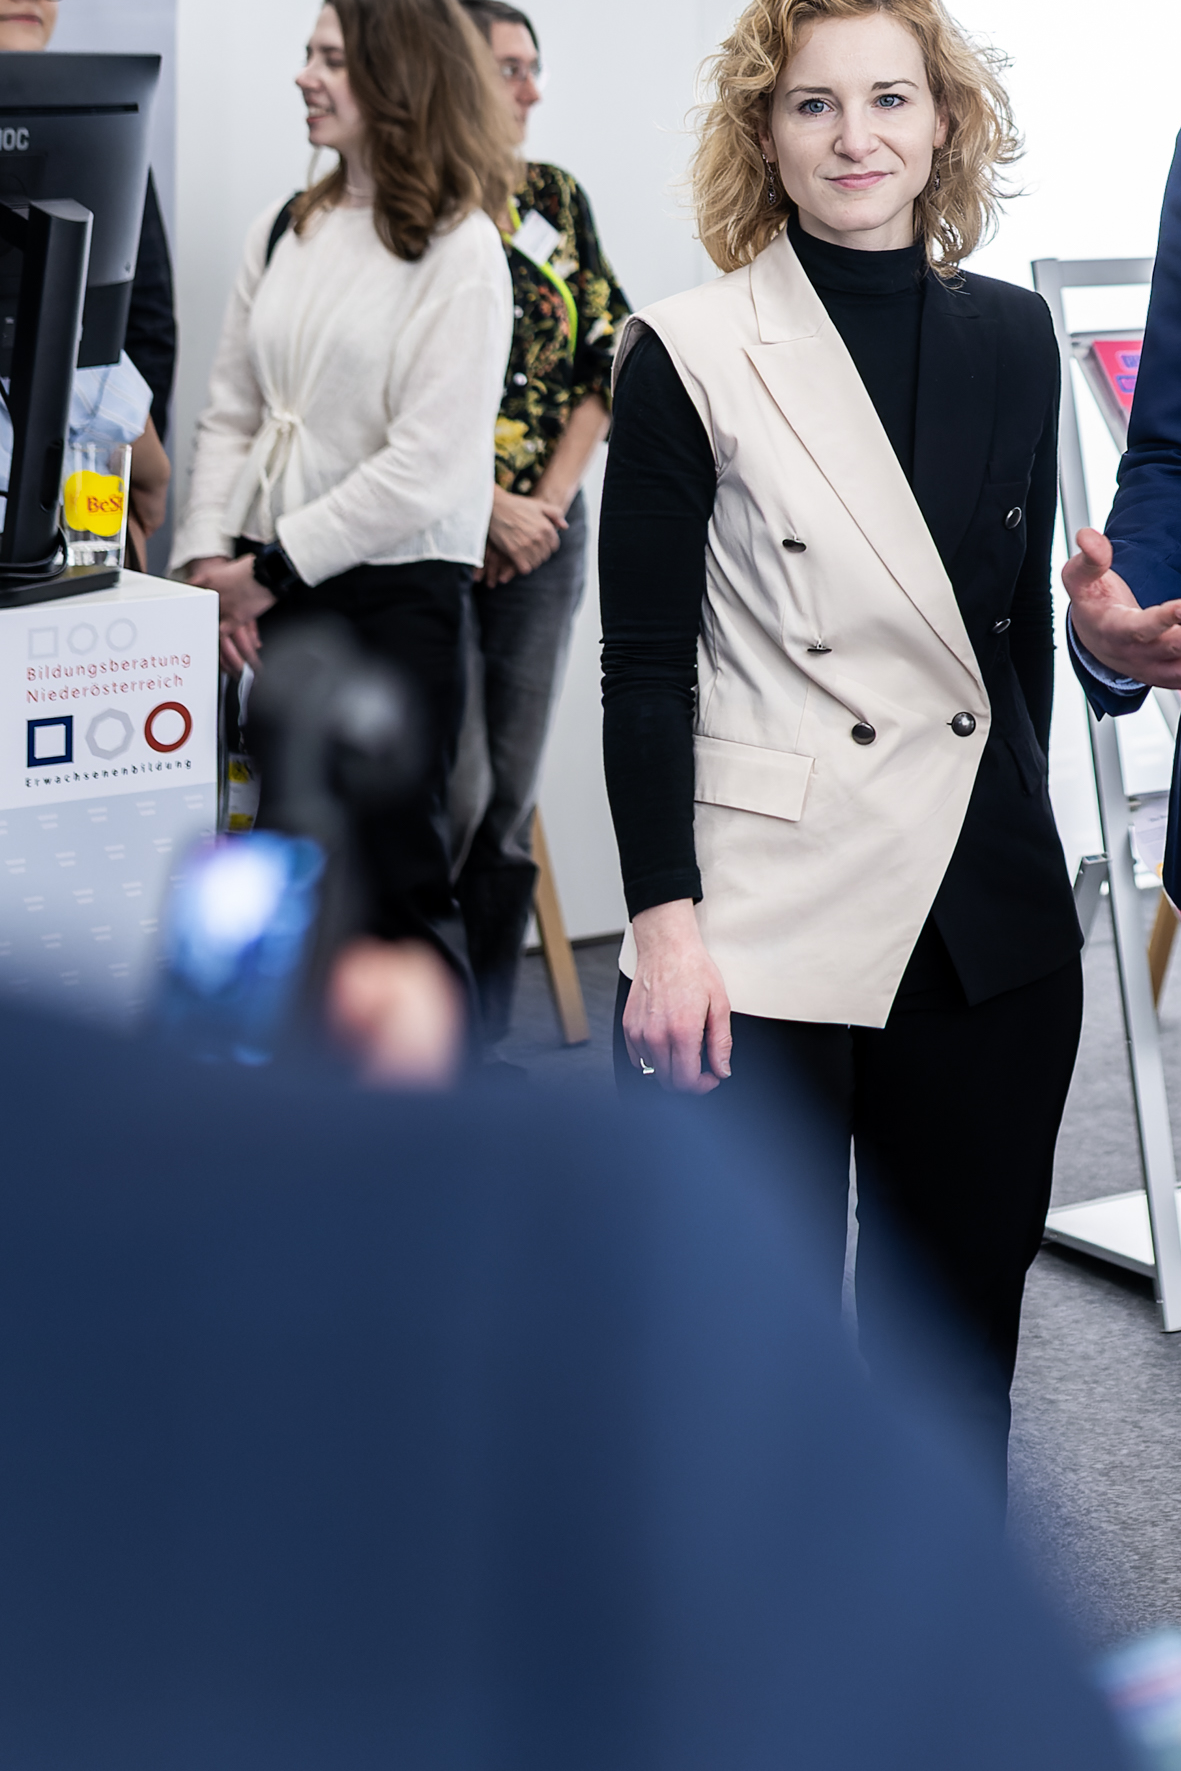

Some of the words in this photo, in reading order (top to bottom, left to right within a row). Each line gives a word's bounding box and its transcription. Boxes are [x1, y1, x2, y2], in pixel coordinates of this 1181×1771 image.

[0, 127, 30, 151] OC
[26, 653, 192, 682] Bildungsberatung
[26, 674, 183, 703] Niederösterreich
[25, 759, 192, 787] Erwachsenenbildung
